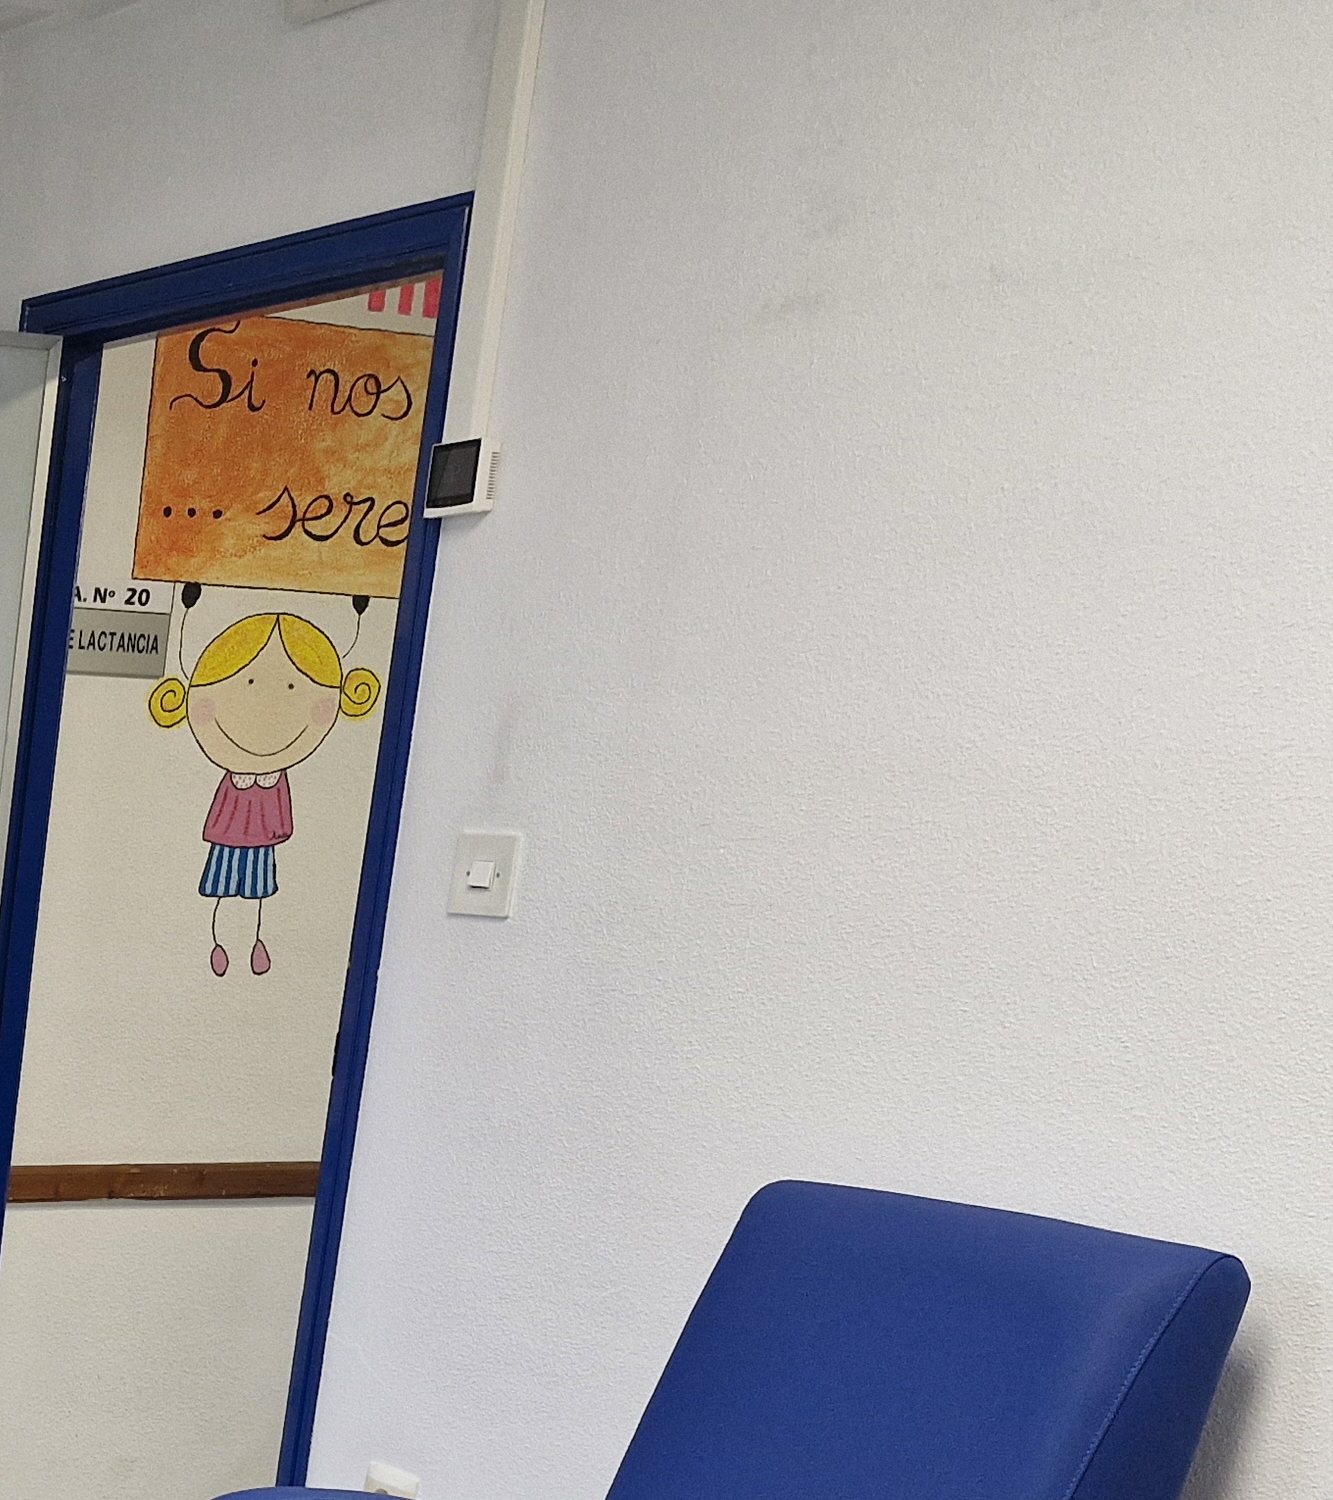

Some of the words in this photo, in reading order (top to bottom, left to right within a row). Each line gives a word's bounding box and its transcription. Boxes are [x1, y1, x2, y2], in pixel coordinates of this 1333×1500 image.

[169, 319, 266, 412] Si
[306, 367, 413, 421] nos
[124, 588, 151, 606] 20
[78, 629, 159, 655] LACTANCIA
